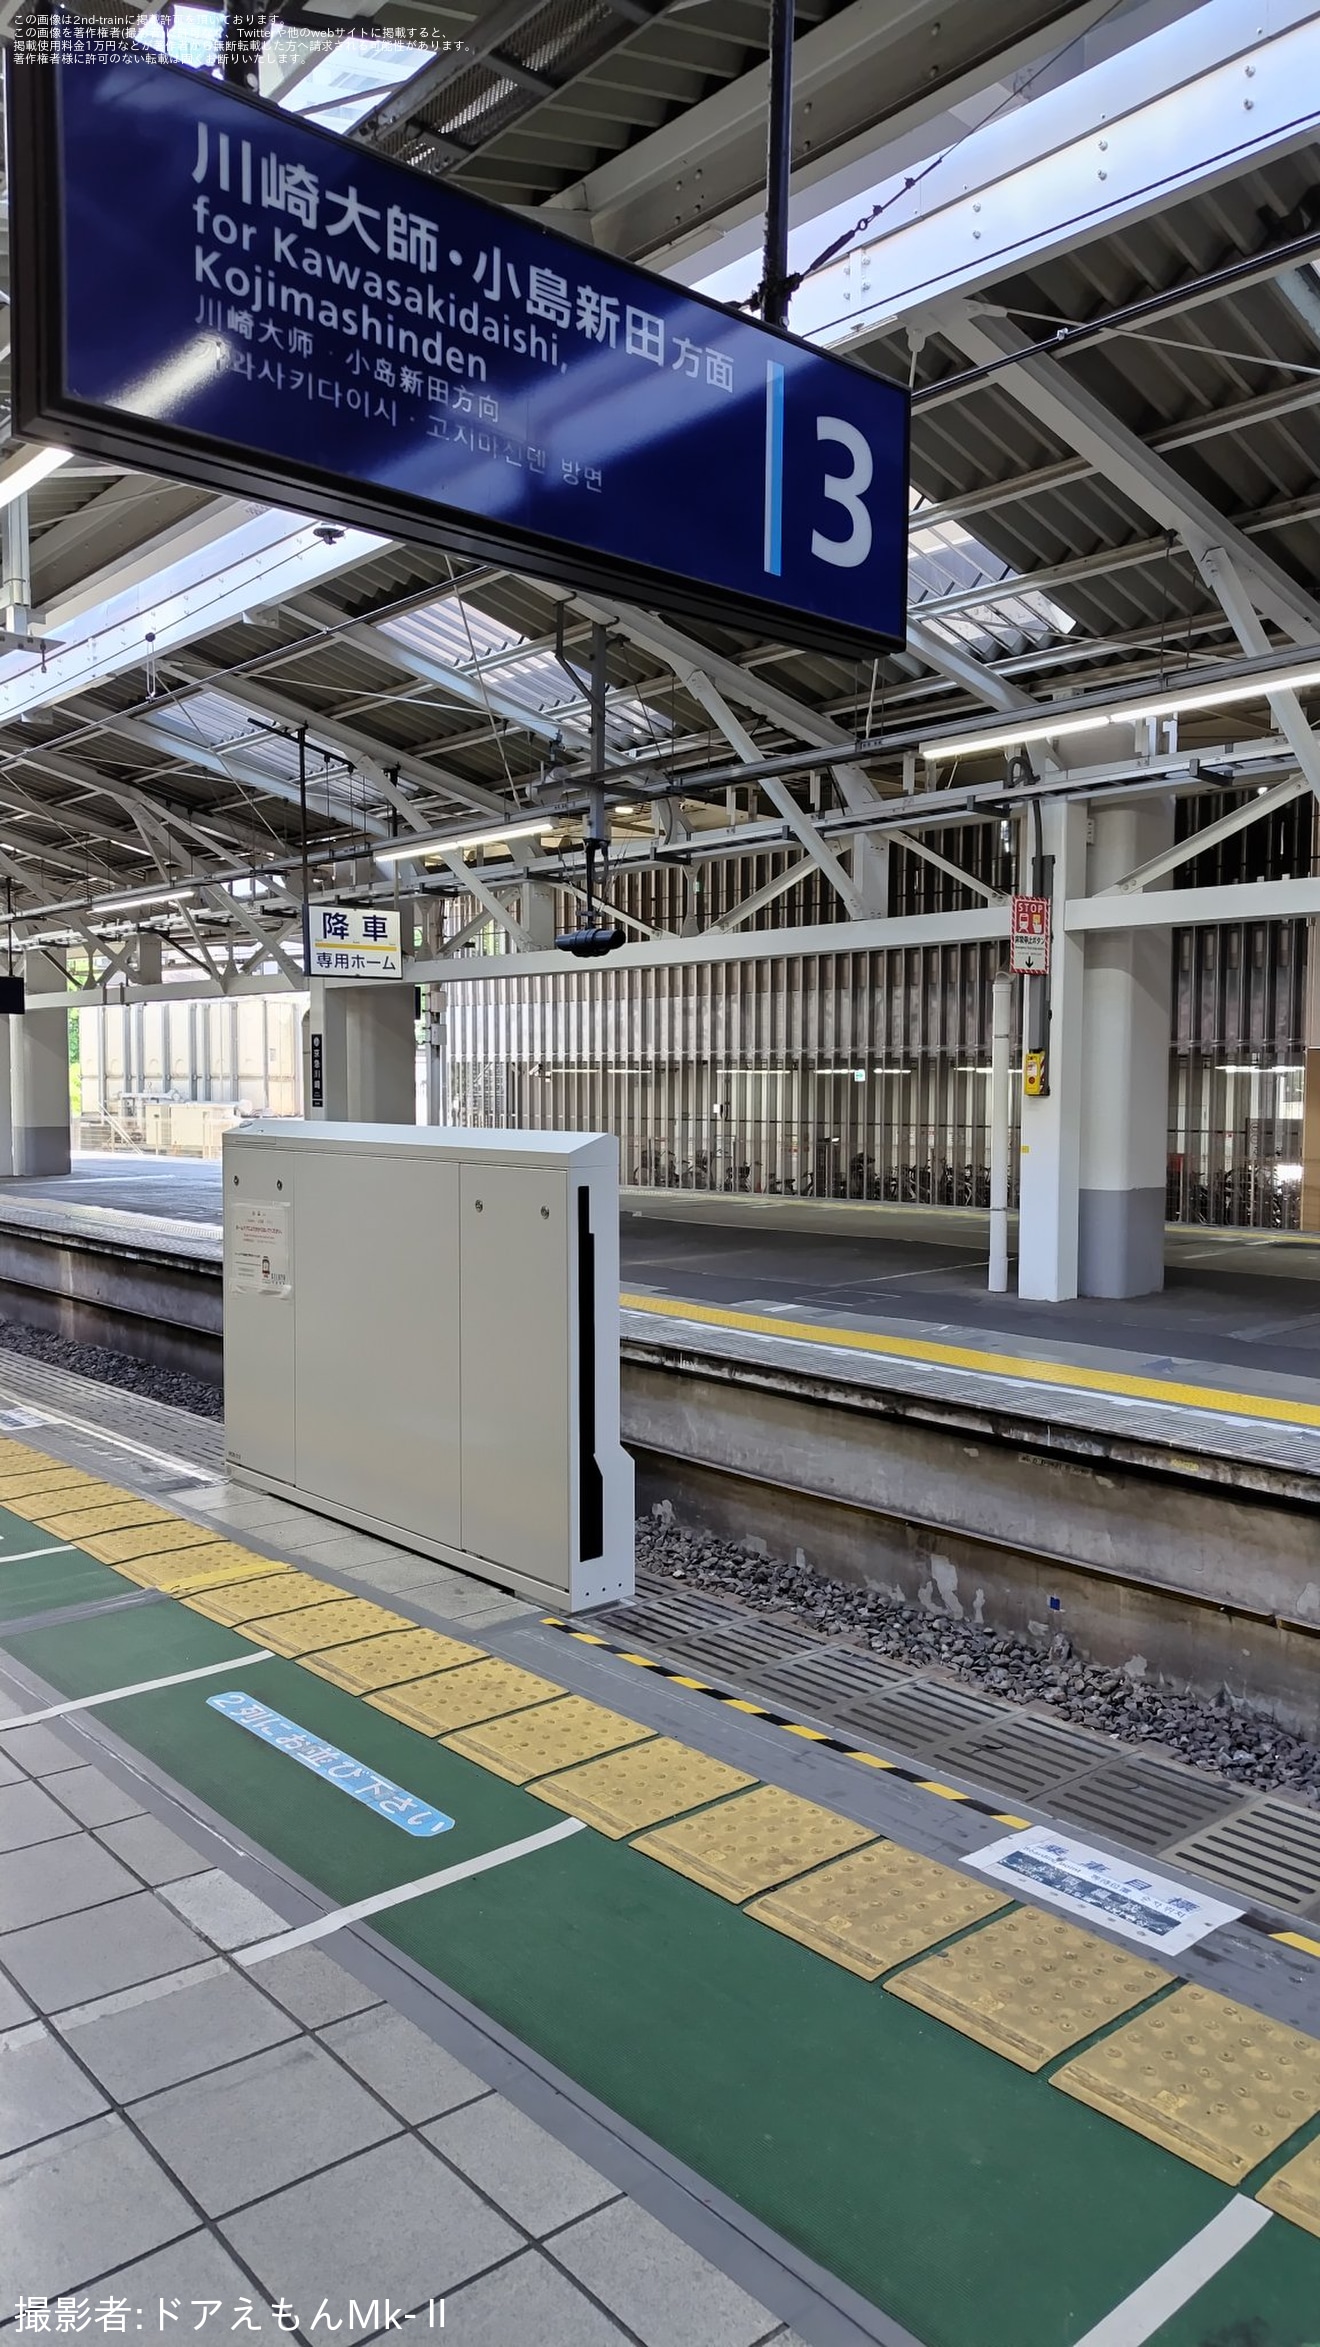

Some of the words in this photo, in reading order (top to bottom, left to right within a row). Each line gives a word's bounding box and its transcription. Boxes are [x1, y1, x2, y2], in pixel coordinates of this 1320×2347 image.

[193, 195, 257, 251] for
[274, 226, 567, 374] Kawasakidaishi,
[195, 245, 488, 383] Kojimashinden
[562, 458, 603, 494] 방면
[811, 416, 873, 568] 3
[322, 911, 389, 942] 降車
[1018, 902, 1043, 914] STOP
[316, 952, 397, 971] 専用ホーム
[213, 1694, 446, 1833] 2列にお並び下さい
